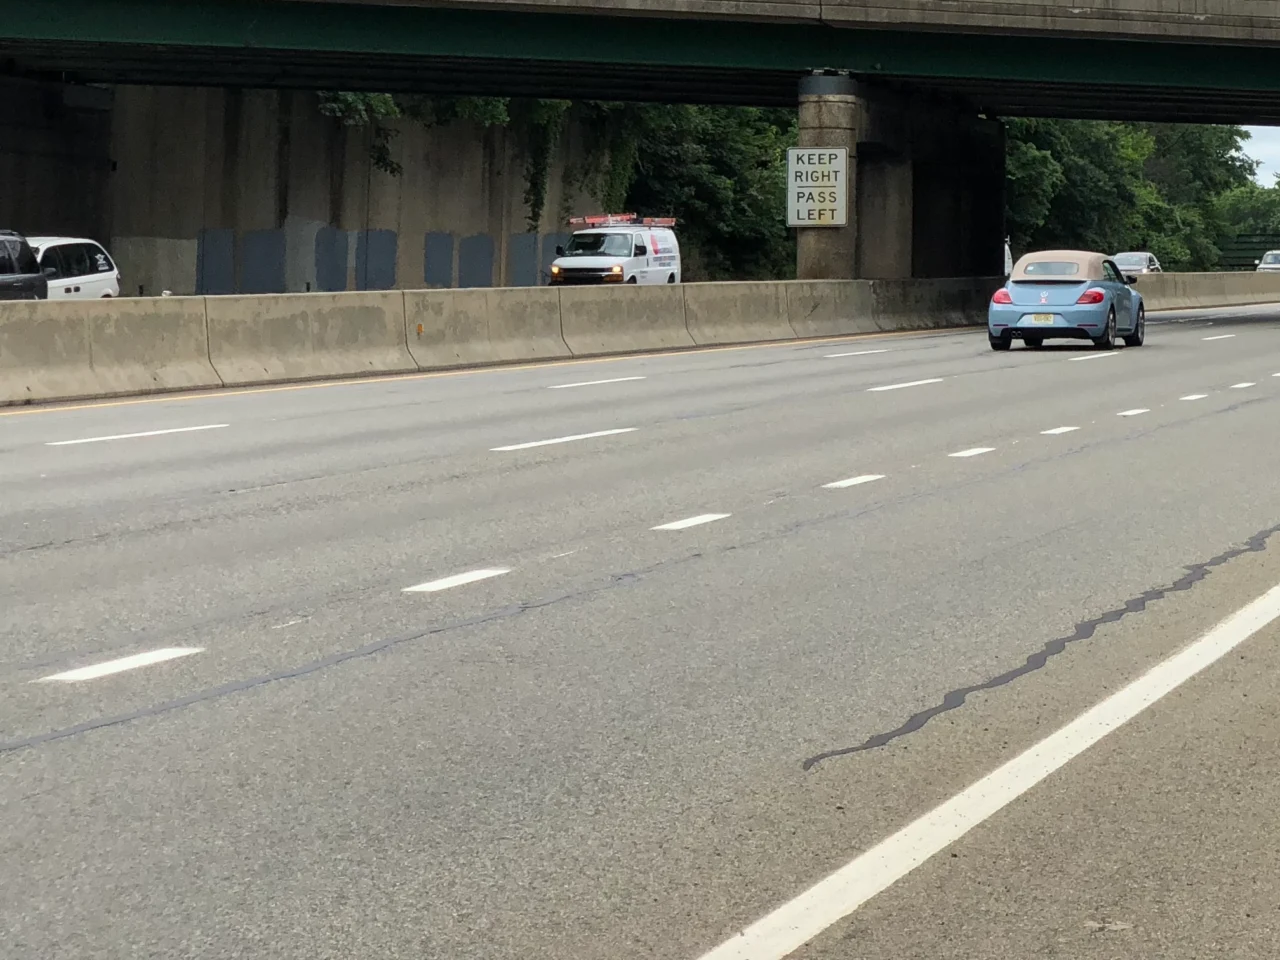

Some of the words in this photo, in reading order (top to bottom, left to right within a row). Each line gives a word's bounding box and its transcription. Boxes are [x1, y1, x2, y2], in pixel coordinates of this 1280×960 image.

[796, 153, 838, 165] KEEP
[794, 170, 840, 182] RIGHT
[796, 191, 837, 203] PASS
[796, 208, 838, 221] LEFT
